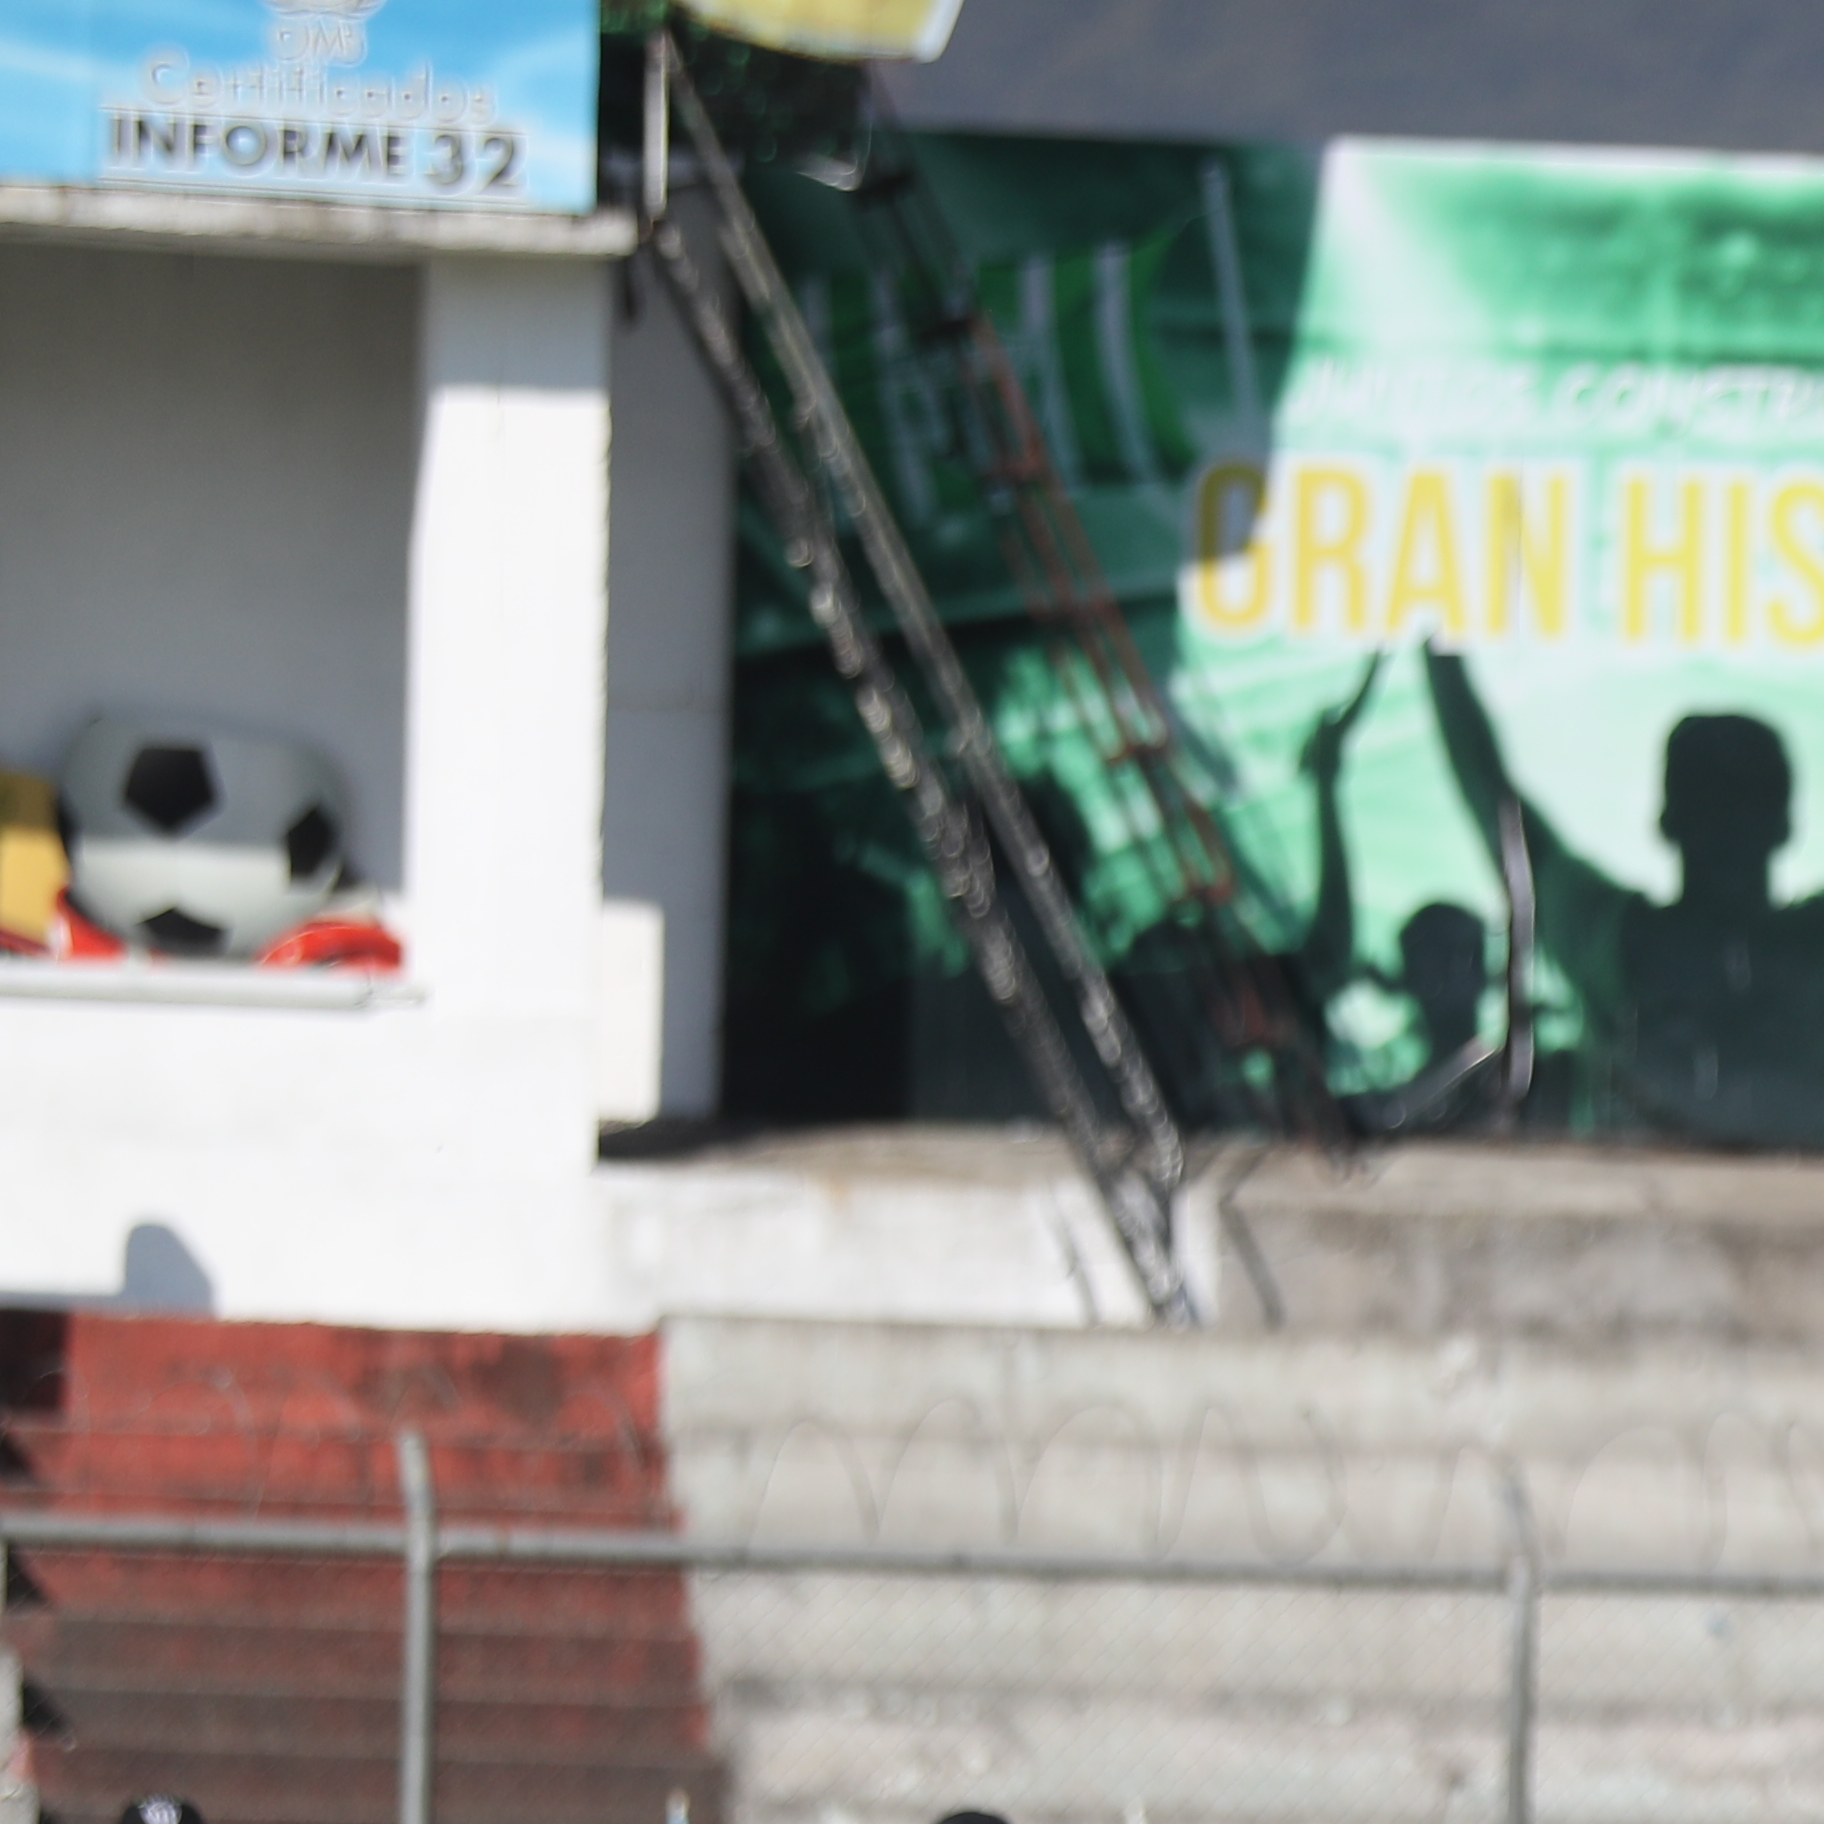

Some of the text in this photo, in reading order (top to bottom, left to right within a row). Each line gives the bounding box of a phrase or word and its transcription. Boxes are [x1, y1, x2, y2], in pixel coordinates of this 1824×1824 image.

[110, 114, 525, 194] INFORME 32
[1196, 464, 1566, 634] GRAN
